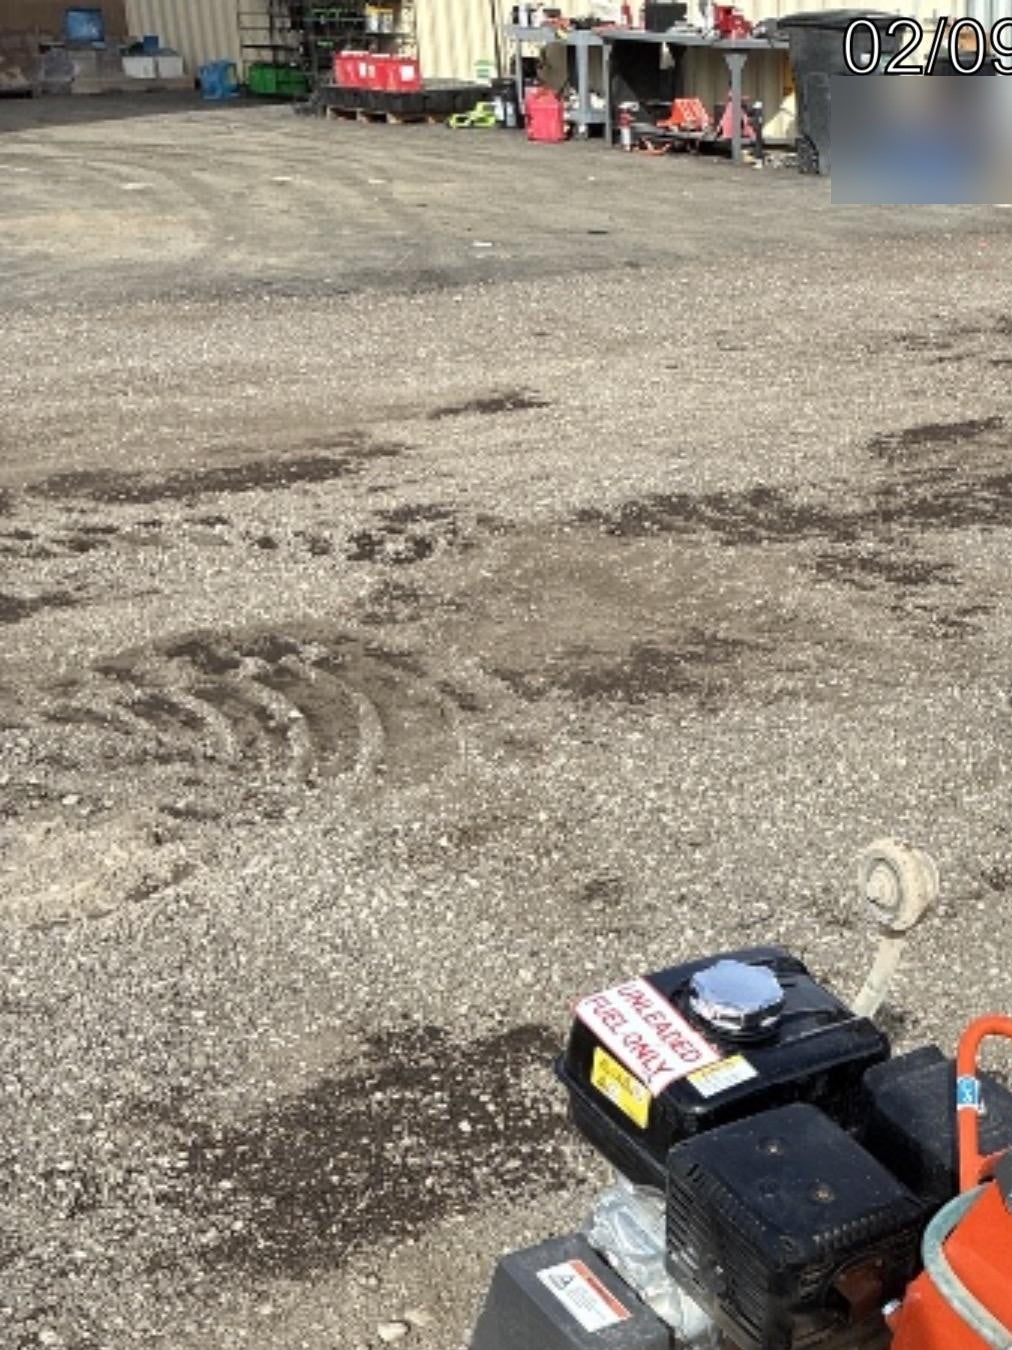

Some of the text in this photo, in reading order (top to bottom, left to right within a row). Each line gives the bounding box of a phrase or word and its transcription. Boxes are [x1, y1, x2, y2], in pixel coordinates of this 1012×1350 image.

[585, 996, 628, 1036] FUEL
[622, 1031, 676, 1076] ONLY
[617, 983, 702, 1064] UNLEADED
